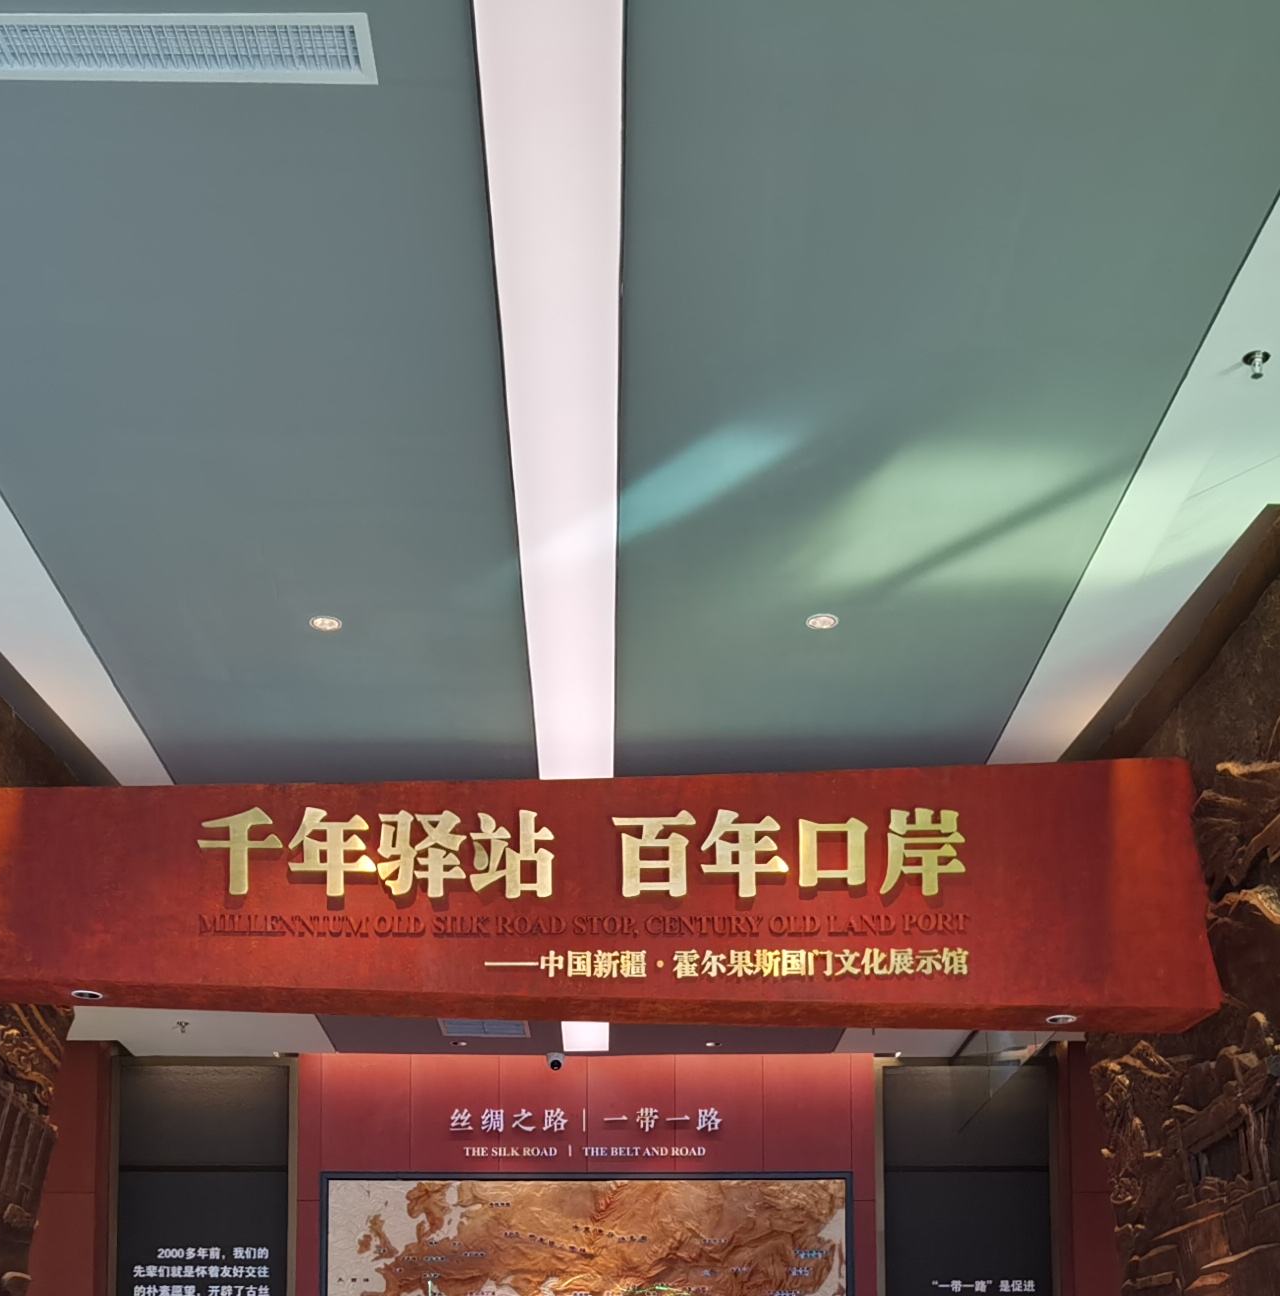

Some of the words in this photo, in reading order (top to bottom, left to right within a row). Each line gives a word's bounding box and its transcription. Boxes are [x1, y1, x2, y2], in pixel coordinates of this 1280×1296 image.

[197, 806, 555, 899] 千年驿站
[611, 807, 967, 898] 百年口岸
[199, 914, 369, 938] MILLENNIUM
[374, 914, 426, 938] OLD
[431, 914, 492, 938] SILK
[495, 914, 567, 936] ROAD
[572, 914, 639, 939] STOP,
[644, 914, 763, 937] CENTURY
[769, 914, 821, 937] OLD
[827, 914, 896, 936] LAND
[901, 912, 970, 934] PORT
[449, 1107, 568, 1133] 丝绸之路
[603, 1107, 722, 1133] 一带一路
[463, 1146, 489, 1157] THE
[491, 1146, 520, 1157] SILK
[523, 1146, 558, 1157] ROAD
[582, 1146, 608, 1157] THE
[610, 1146, 641, 1157] BELT
[643, 1146, 669, 1157] AND
[671, 1146, 706, 1157] ROAD
[157, 1247, 270, 1260] 2000多年前，我们的
[133, 1265, 270, 1278] 先辈们就是怀着友好交往
